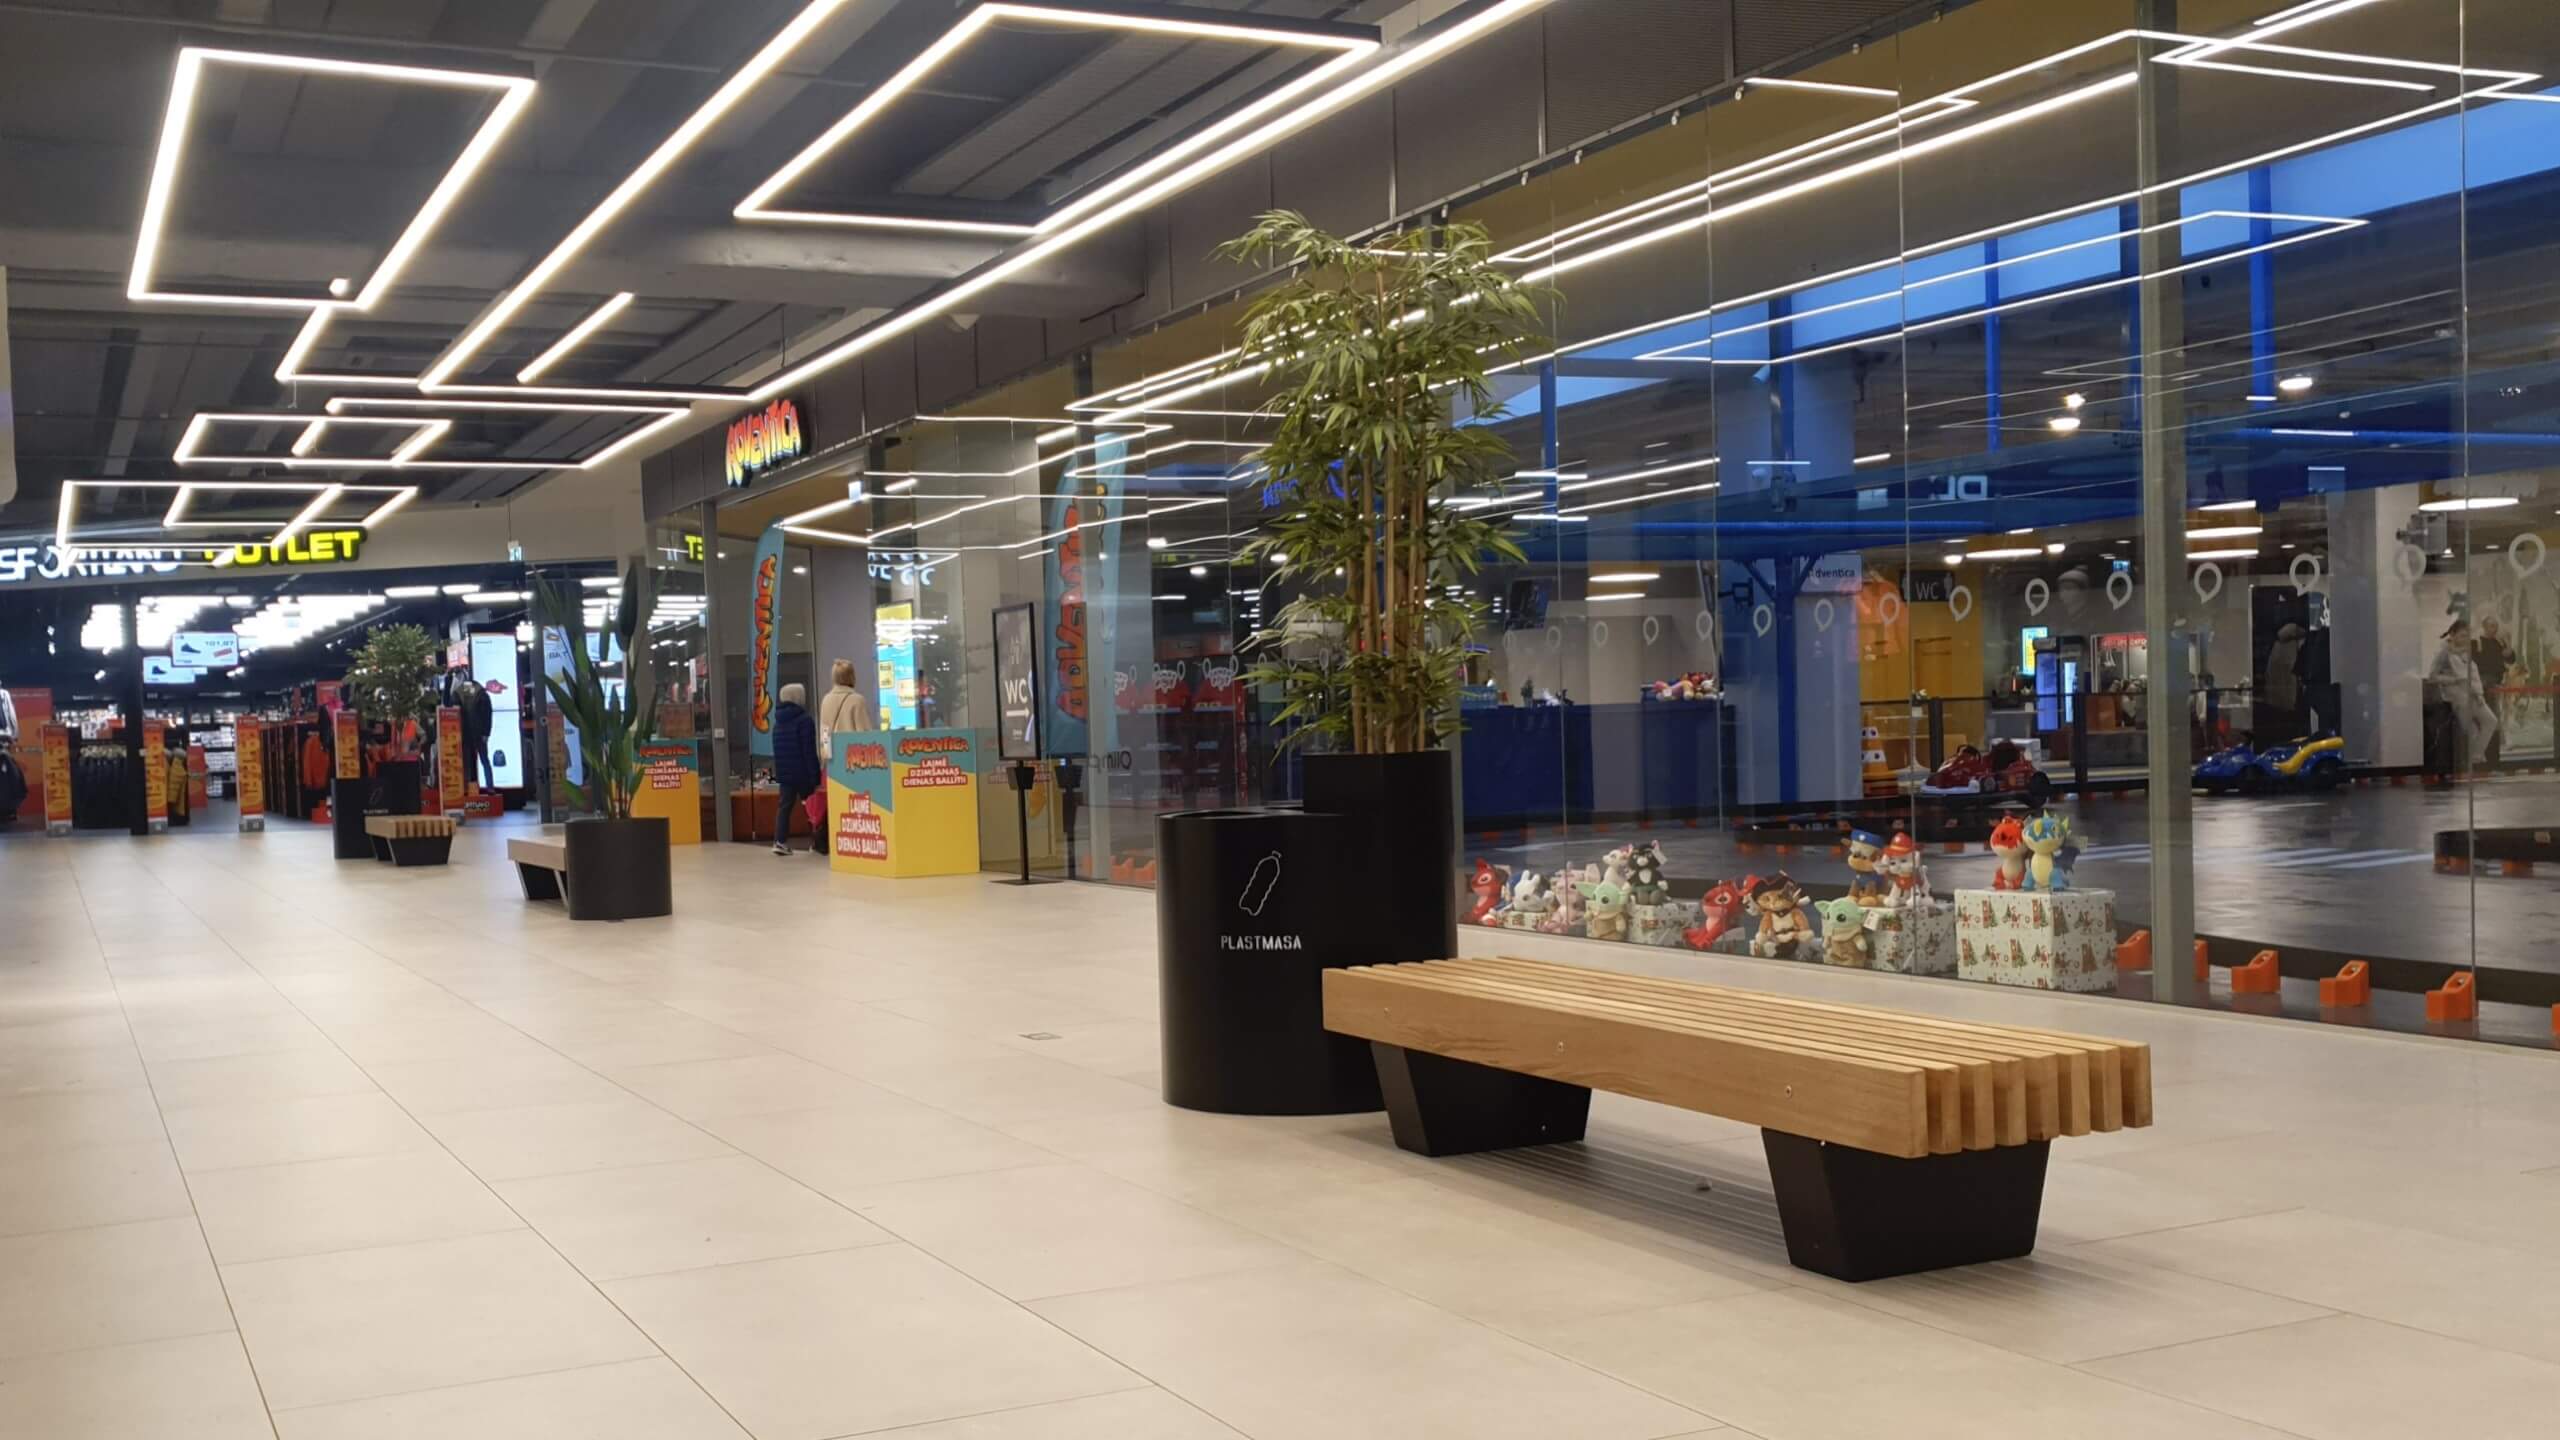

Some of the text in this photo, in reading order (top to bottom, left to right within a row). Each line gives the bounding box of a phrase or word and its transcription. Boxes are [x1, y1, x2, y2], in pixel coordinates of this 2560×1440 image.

[726, 399, 801, 486] ADVENTICA
[1916, 581, 1939, 600] WC
[1005, 678, 1028, 704] WC
[1220, 935, 1302, 950] PLASTMASA
